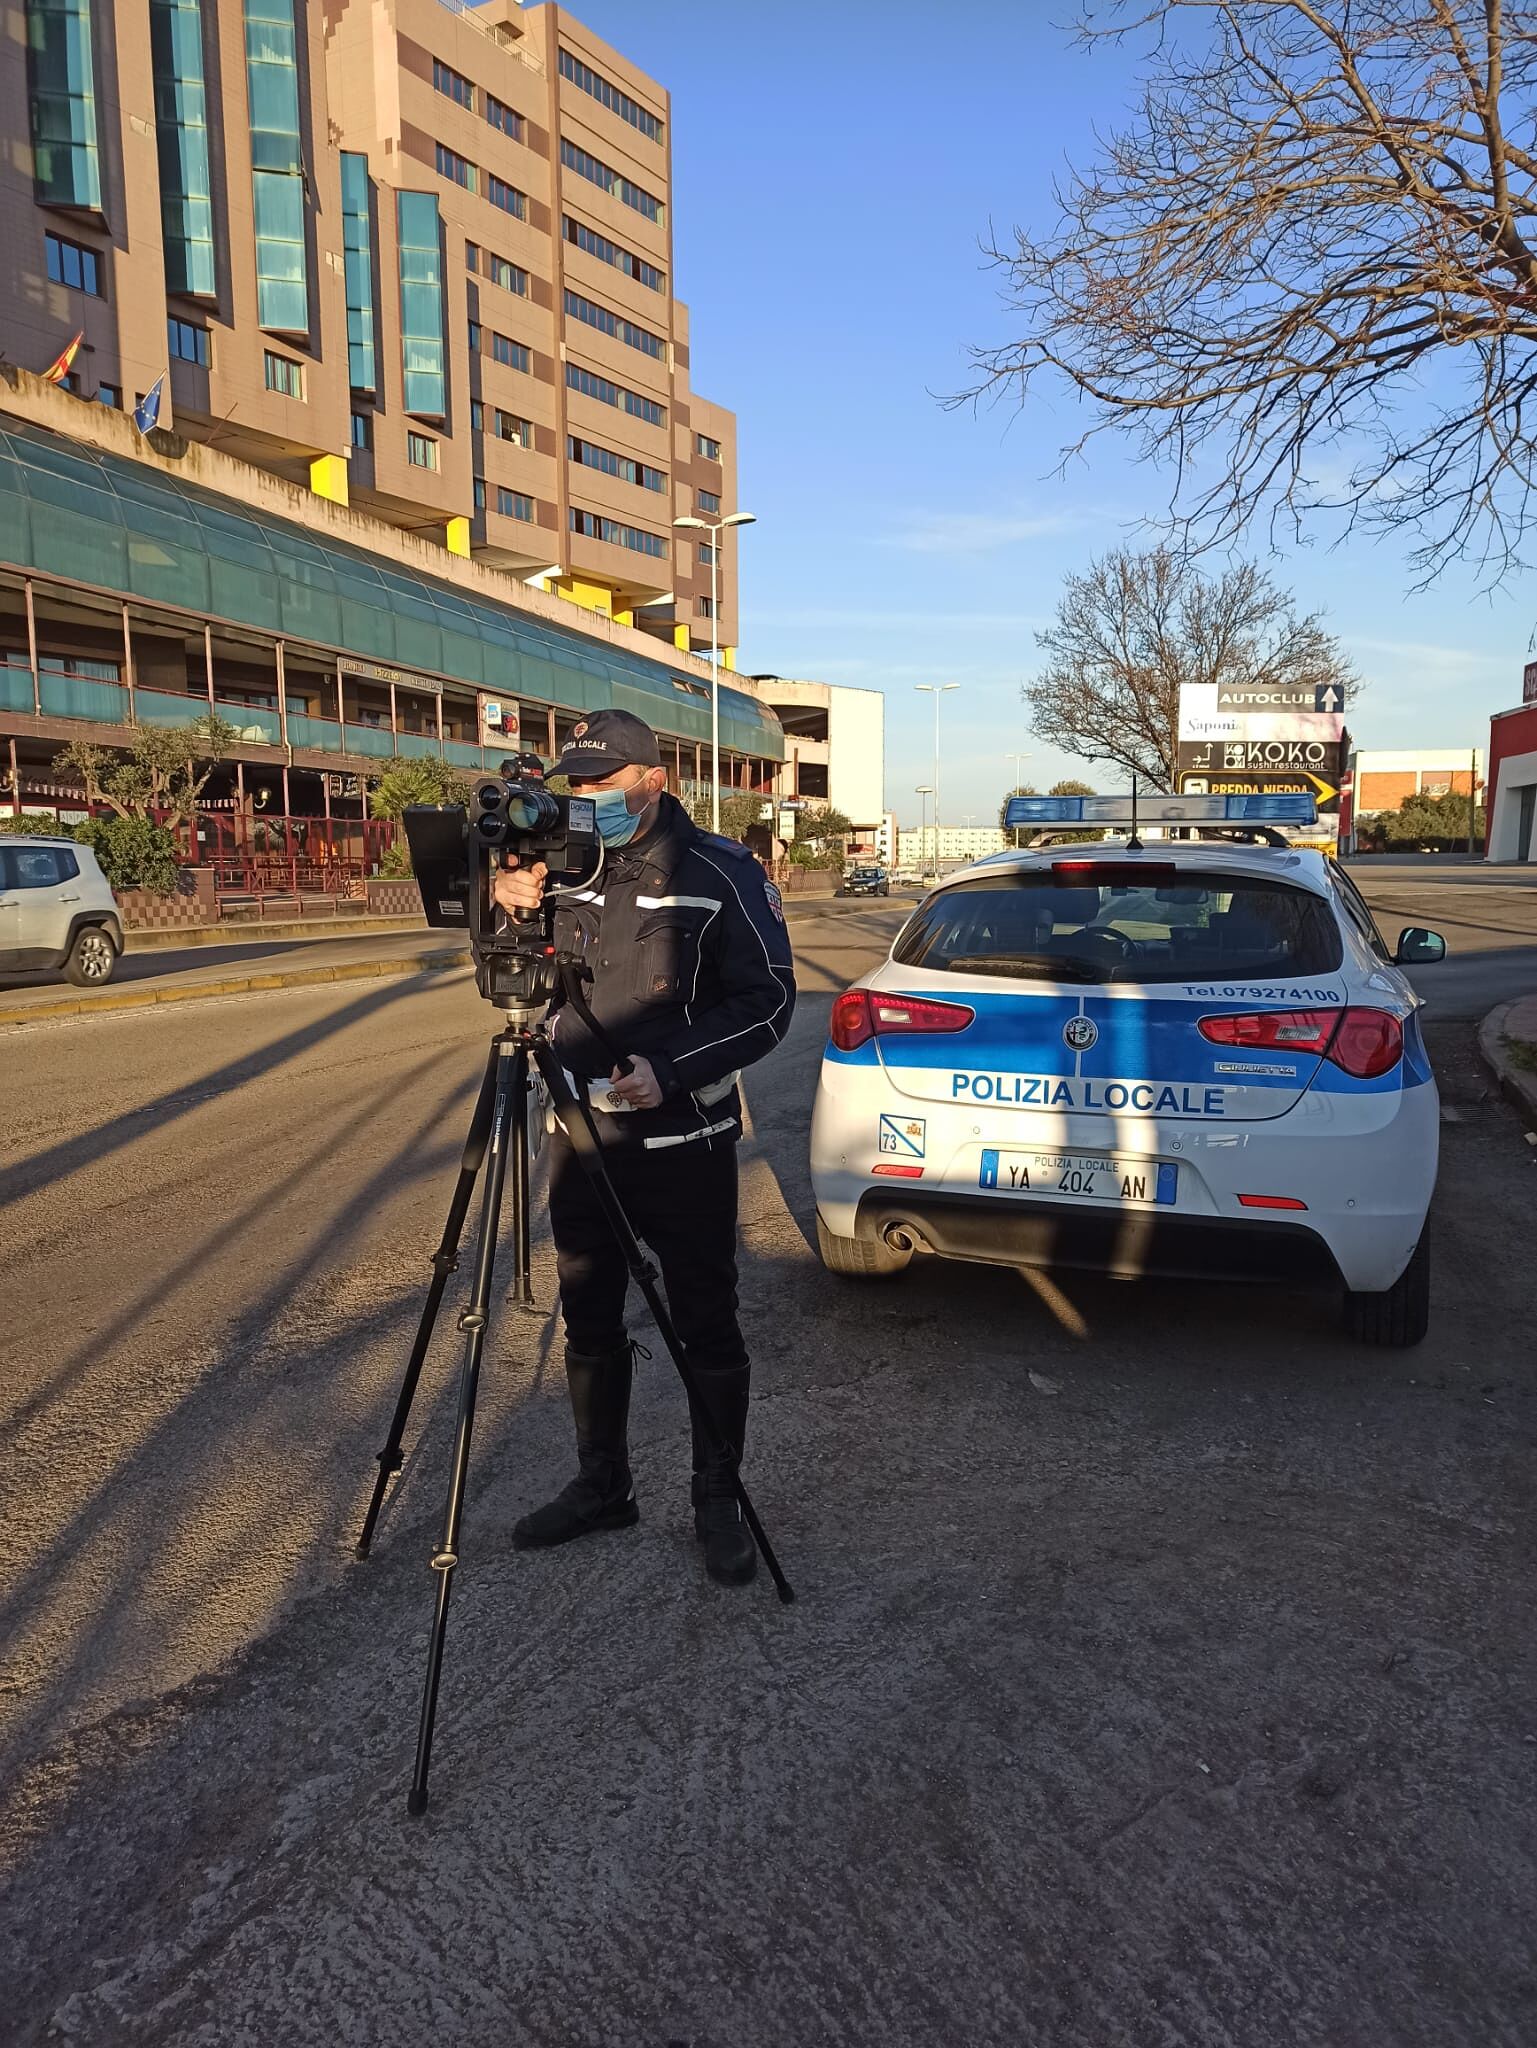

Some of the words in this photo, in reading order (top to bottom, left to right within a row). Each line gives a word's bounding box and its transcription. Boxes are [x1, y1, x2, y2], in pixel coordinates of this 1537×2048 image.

[1219, 693, 1316, 704] AUTOCLUB
[579, 740, 608, 751] LOCALE
[1247, 742, 1326, 762] KOKO
[1247, 761, 1272, 769] sushi
[1274, 761, 1325, 769] restaurant
[1182, 986, 1340, 1002] Tel.079274100
[952, 1073, 1075, 1106] POLIZIA
[1084, 1082, 1225, 1114] LOCALE
[883, 1133, 897, 1150] 73
[1034, 1156, 1072, 1169] POLIZIA
[1079, 1159, 1120, 1173] LOCALE
[1009, 1165, 1031, 1189] YA
[1058, 1170, 1094, 1194] 404
[1120, 1175, 1146, 1199] AN
